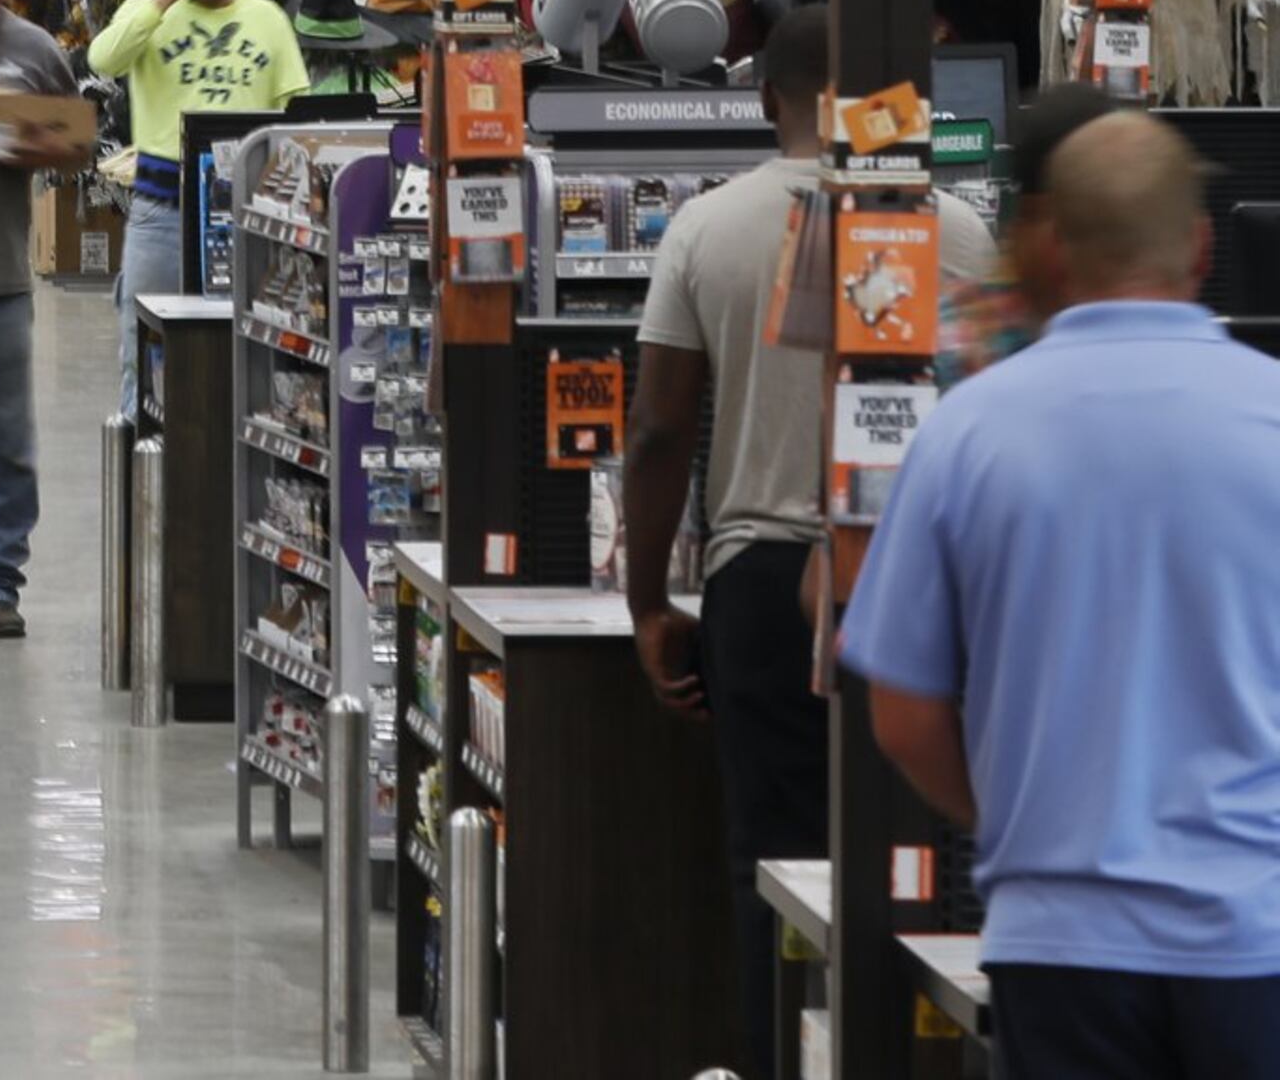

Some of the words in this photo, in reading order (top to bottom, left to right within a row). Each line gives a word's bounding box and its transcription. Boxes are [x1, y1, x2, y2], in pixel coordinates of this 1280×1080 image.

[180, 62, 252, 87] EAGLE
[199, 87, 231, 104] 77
[604, 102, 716, 121] ECONOMICAL
[463, 186, 504, 199] YOU'VE
[460, 199, 508, 211] EARNED
[471, 210, 499, 222] THIS
[858, 396, 915, 412] YOU'VE
[853, 412, 919, 428] EARNED
[868, 428, 904, 445] THIS
